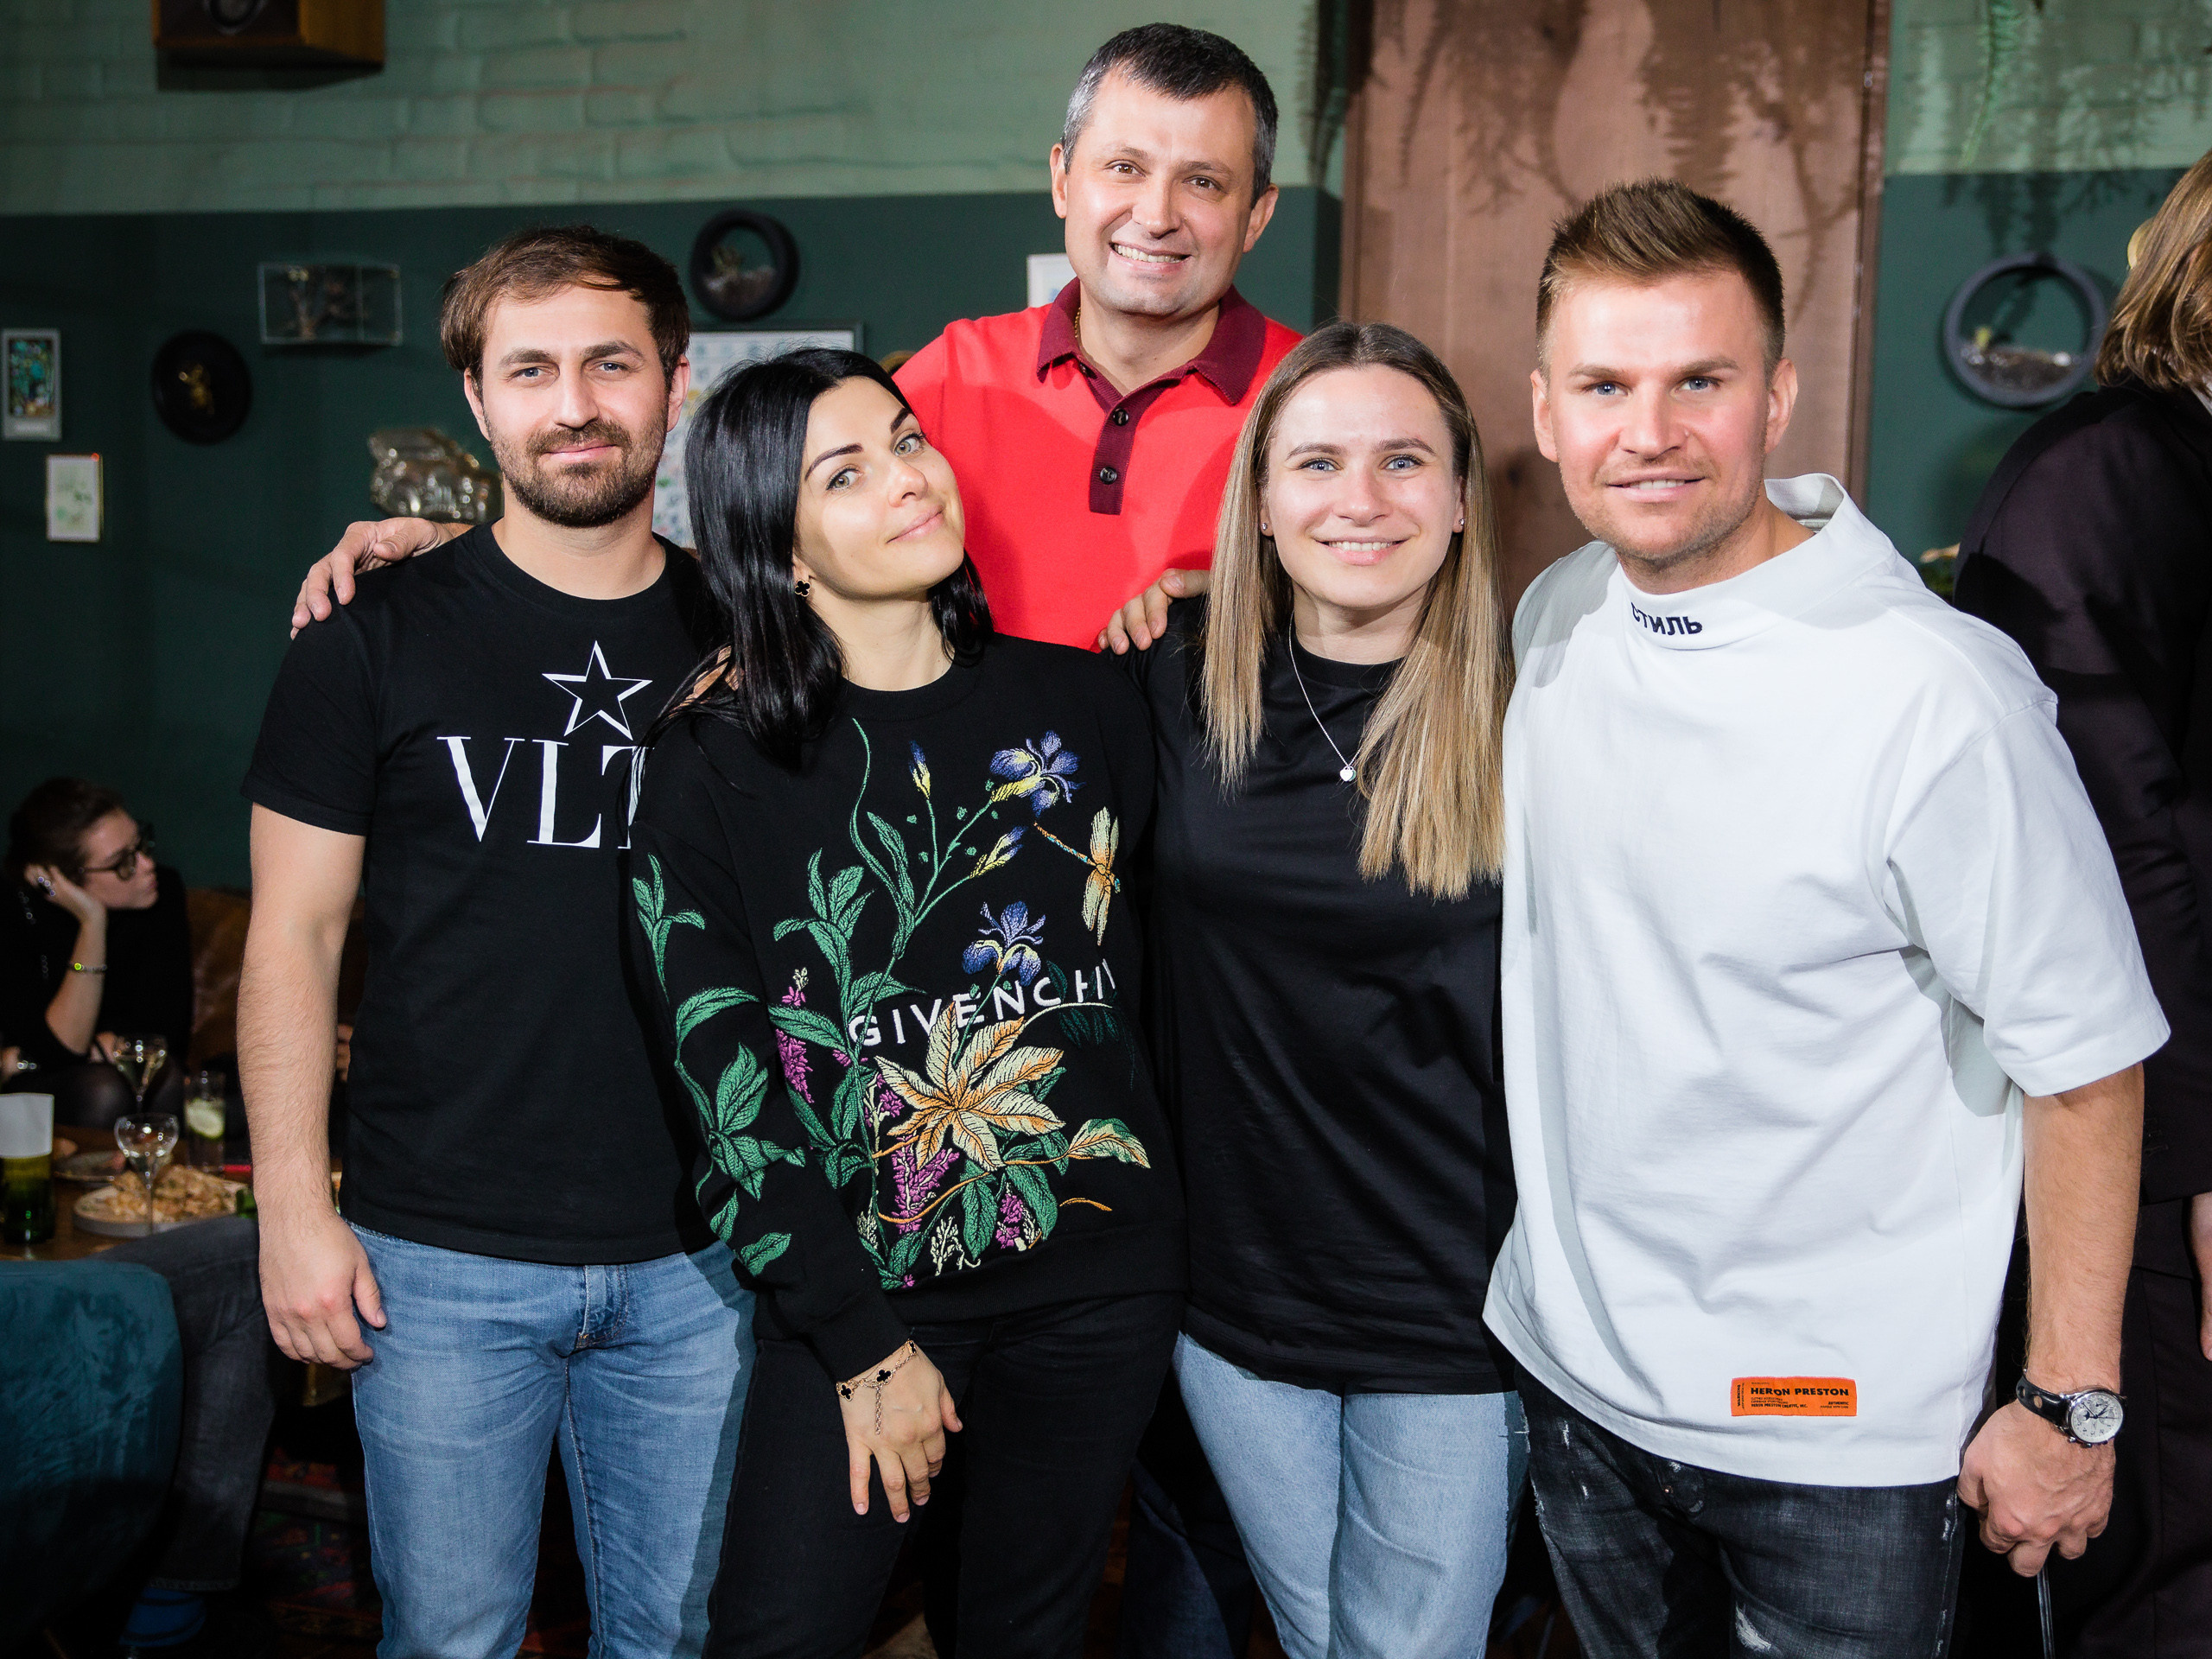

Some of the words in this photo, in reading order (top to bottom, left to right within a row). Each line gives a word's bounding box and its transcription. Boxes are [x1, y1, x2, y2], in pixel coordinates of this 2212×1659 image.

[1630, 601, 1703, 636] СТИЛЬ
[1751, 1387, 1790, 1396] HERON
[1795, 1388, 1849, 1396] PRESTON
